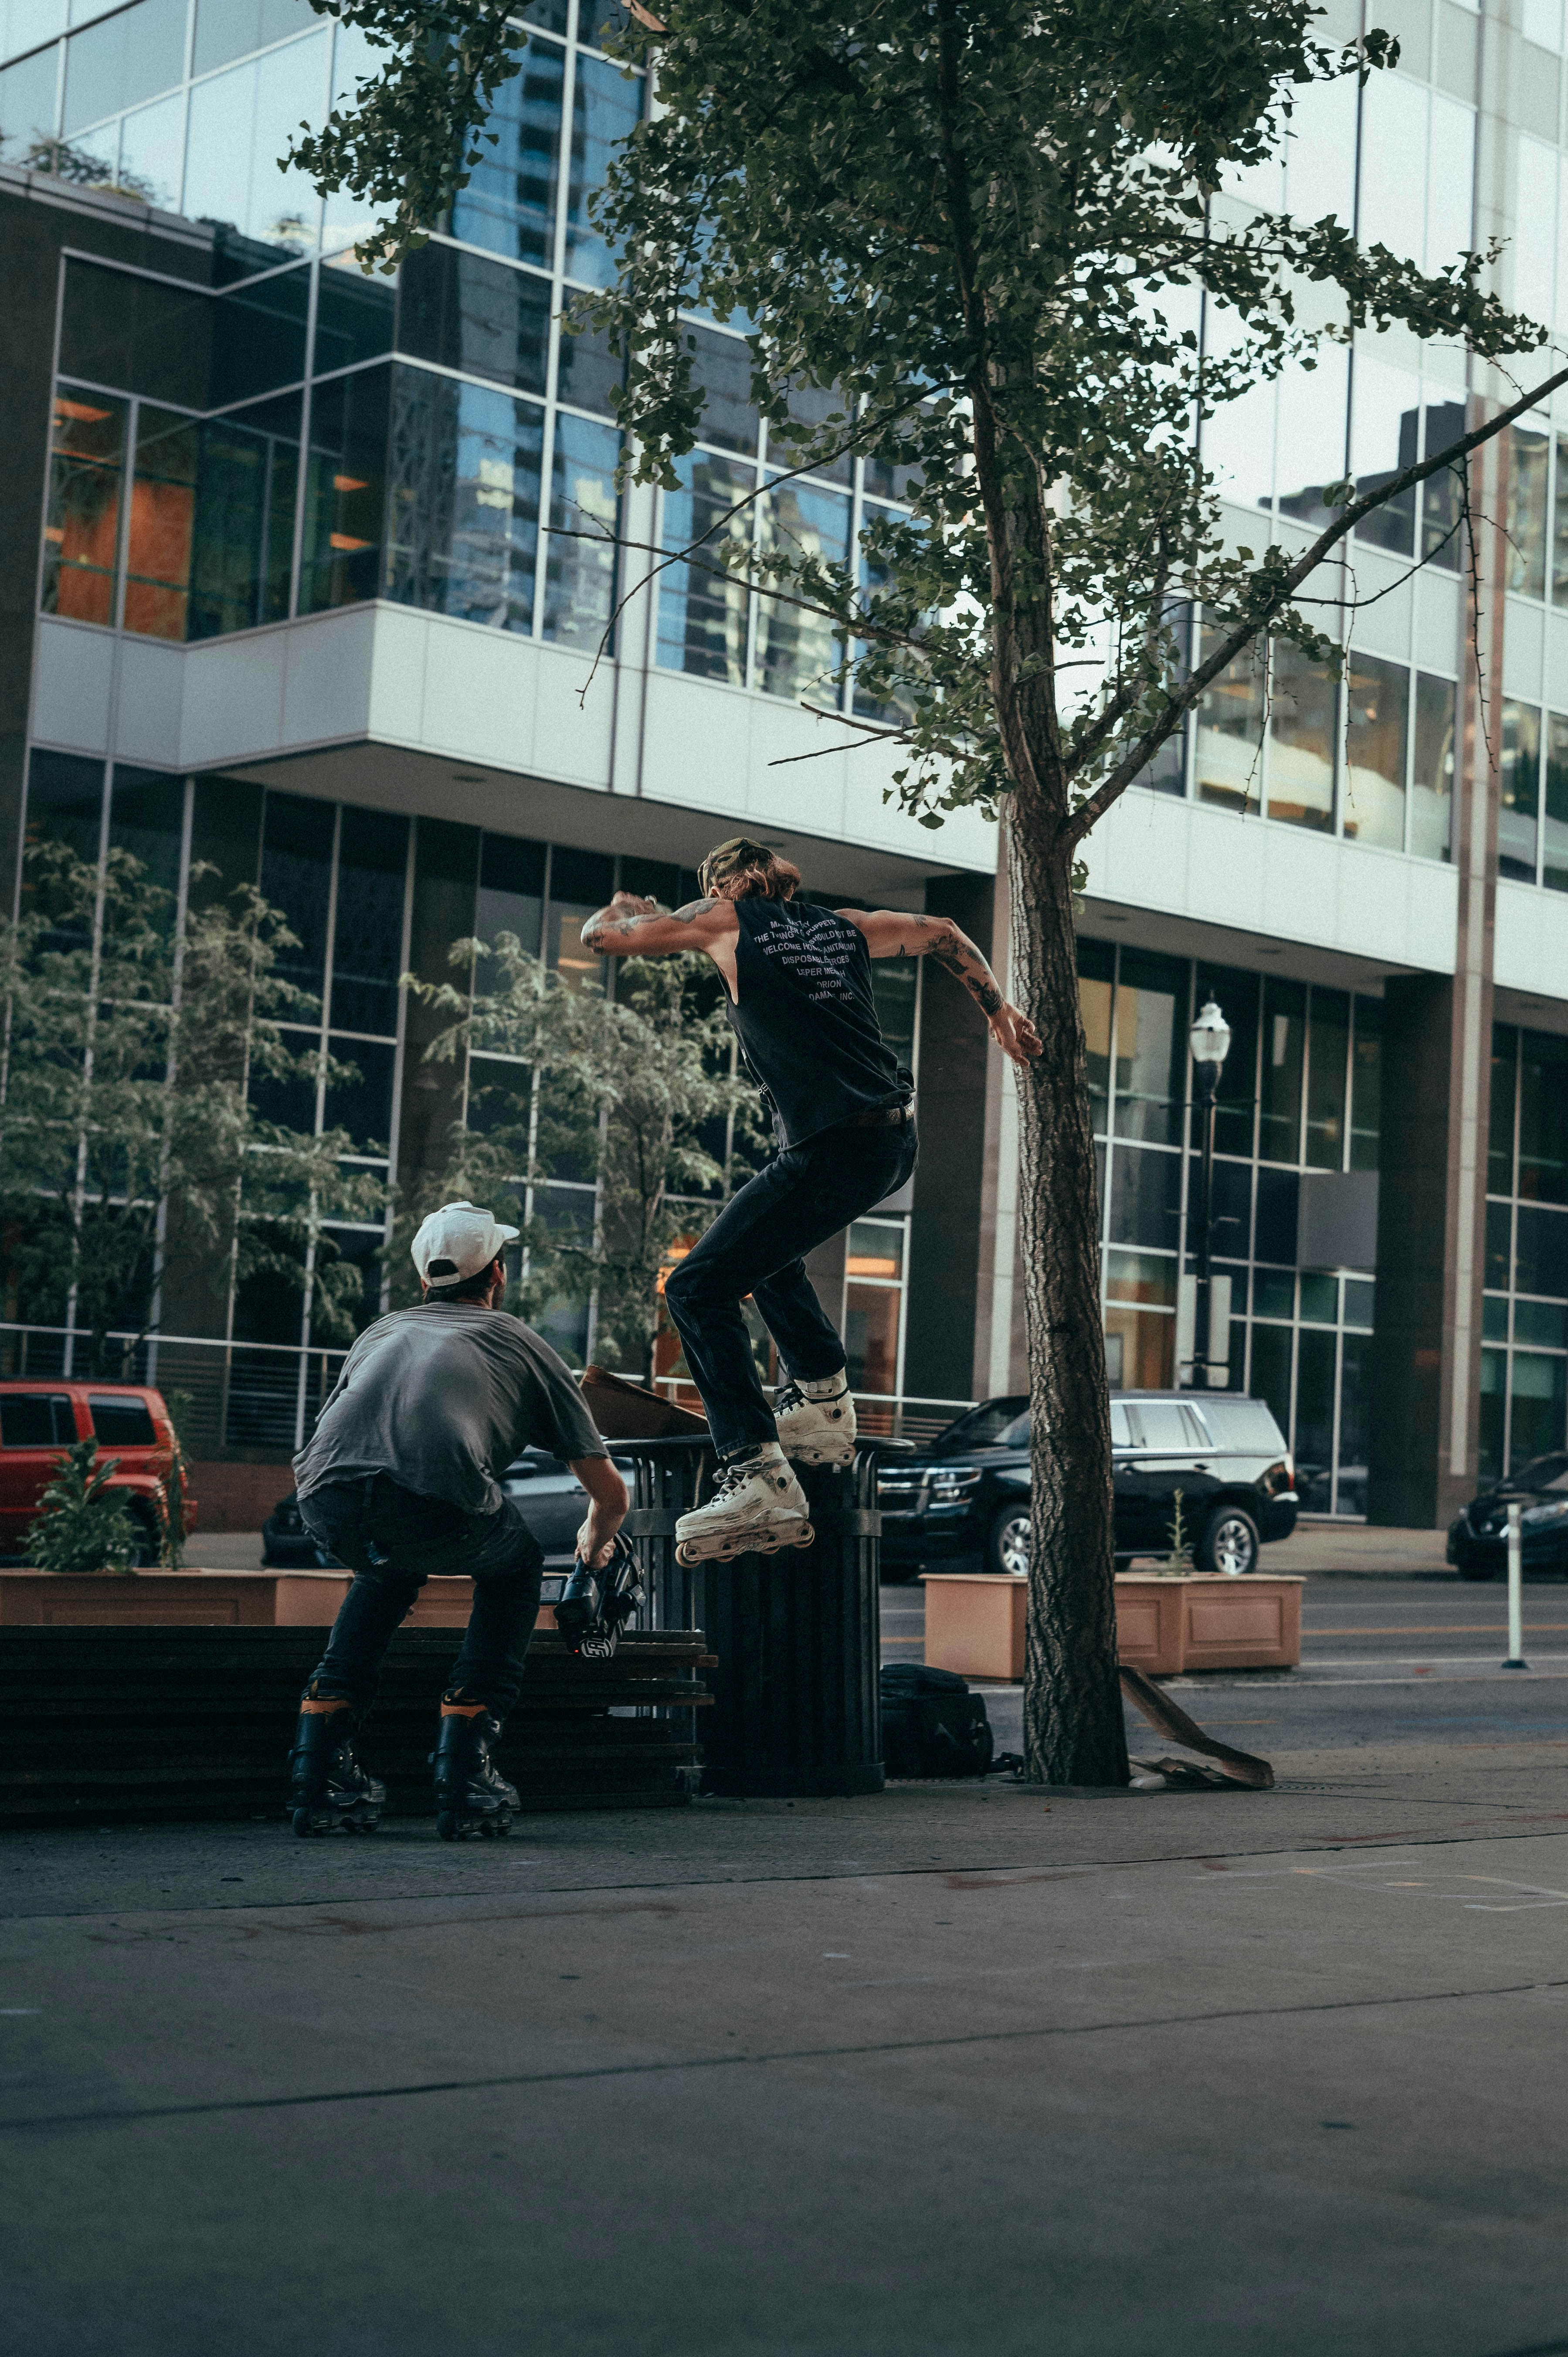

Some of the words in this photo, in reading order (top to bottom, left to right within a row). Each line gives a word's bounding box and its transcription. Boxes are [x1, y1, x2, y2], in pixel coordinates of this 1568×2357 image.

[806, 919, 836, 936] PUPPETS
[753, 933, 769, 943] THE
[808, 930, 835, 945] SHOULD
[840, 992, 855, 1000] INC.
